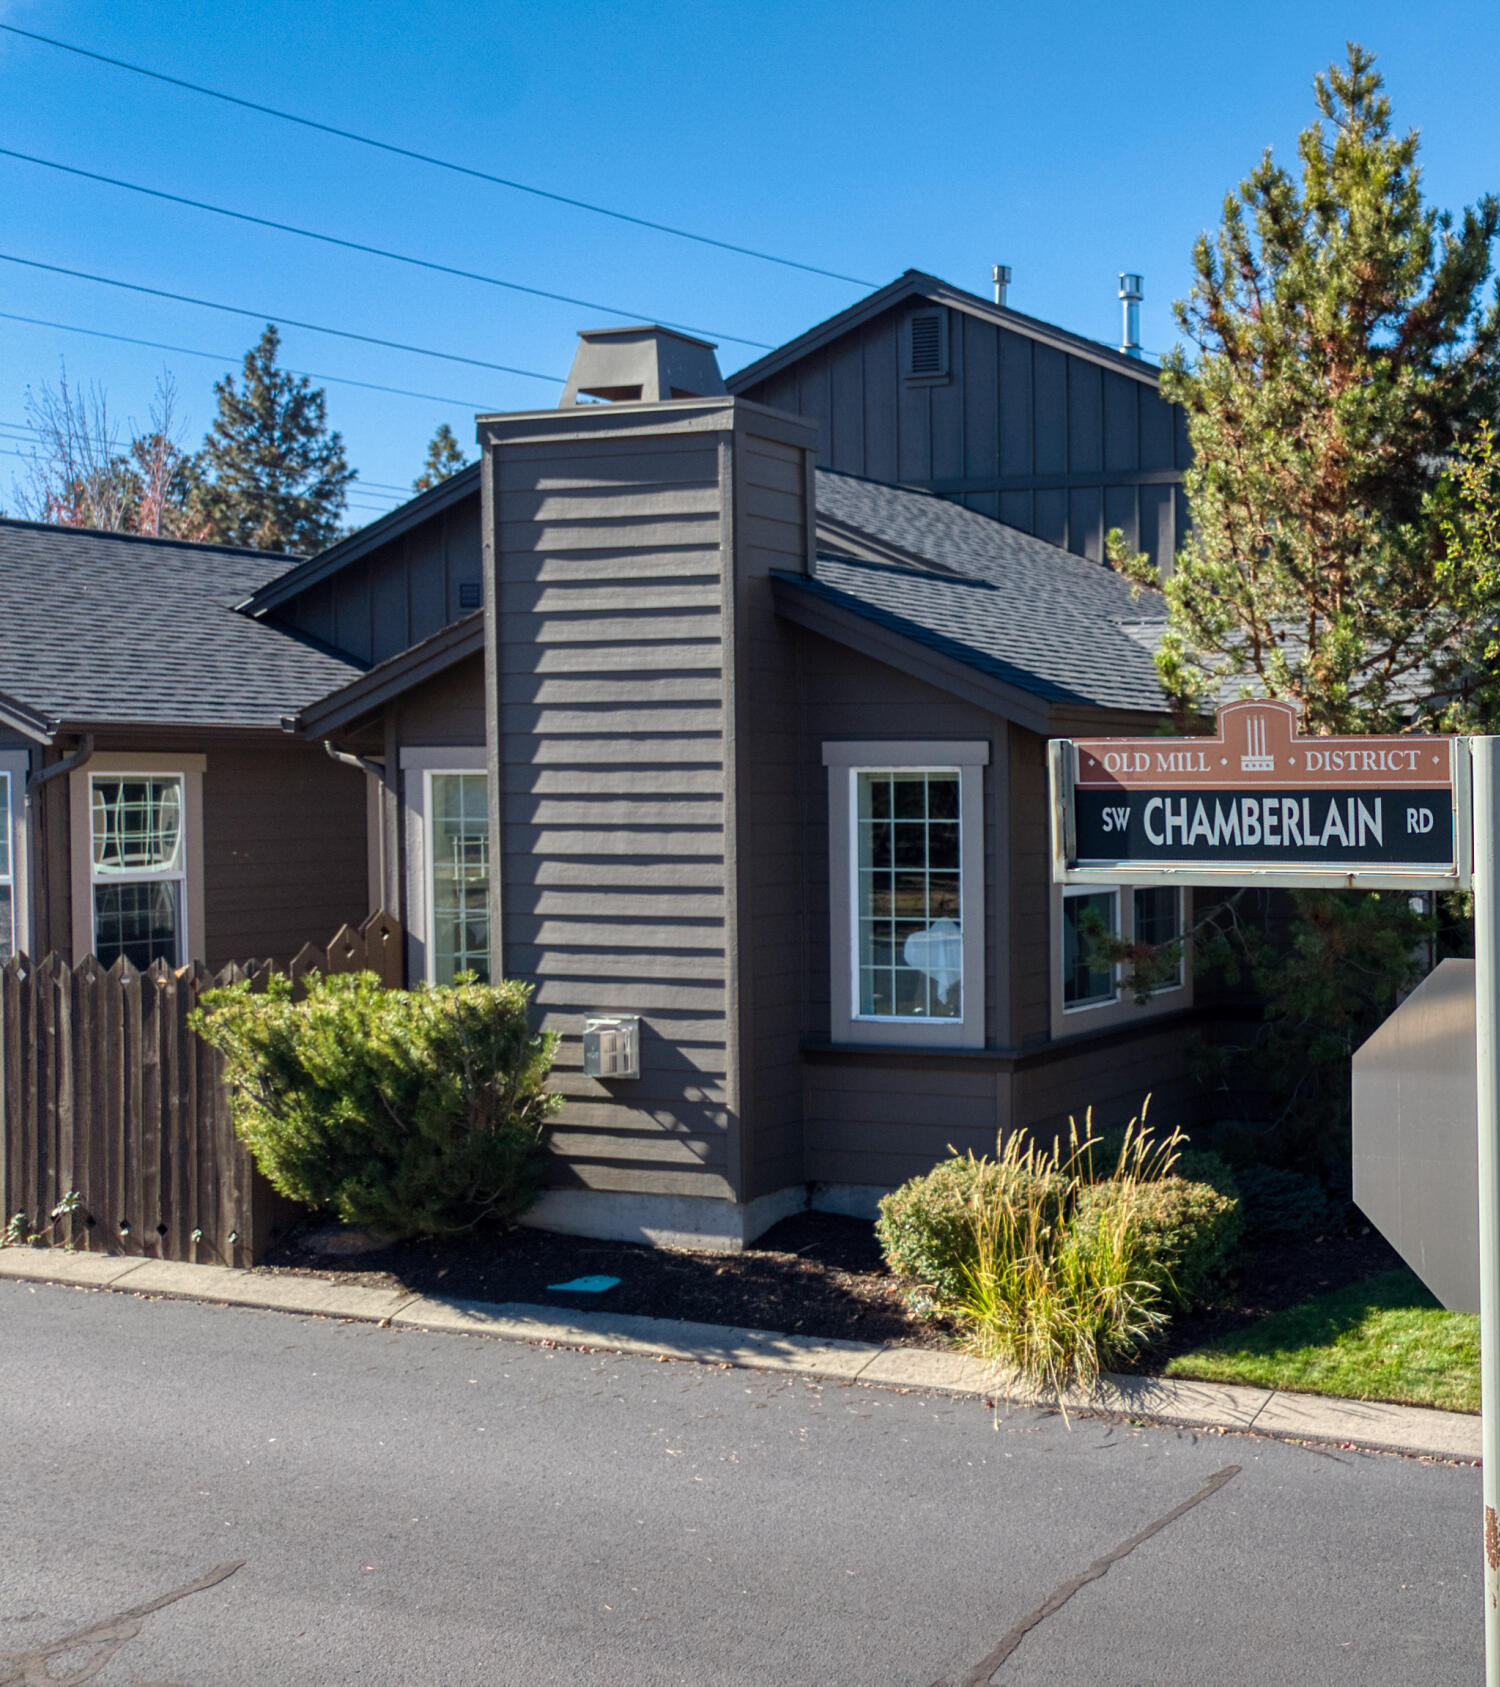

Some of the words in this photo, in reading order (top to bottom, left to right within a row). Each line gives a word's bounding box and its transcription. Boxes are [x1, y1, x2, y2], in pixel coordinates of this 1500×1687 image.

[1103, 752, 1150, 772] OLD
[1156, 751, 1211, 772] MILL
[1305, 750, 1421, 771] DISTRICT
[1102, 807, 1131, 832] SW
[1143, 797, 1383, 847] CHAMBERLAIN
[1406, 808, 1434, 834] RD
